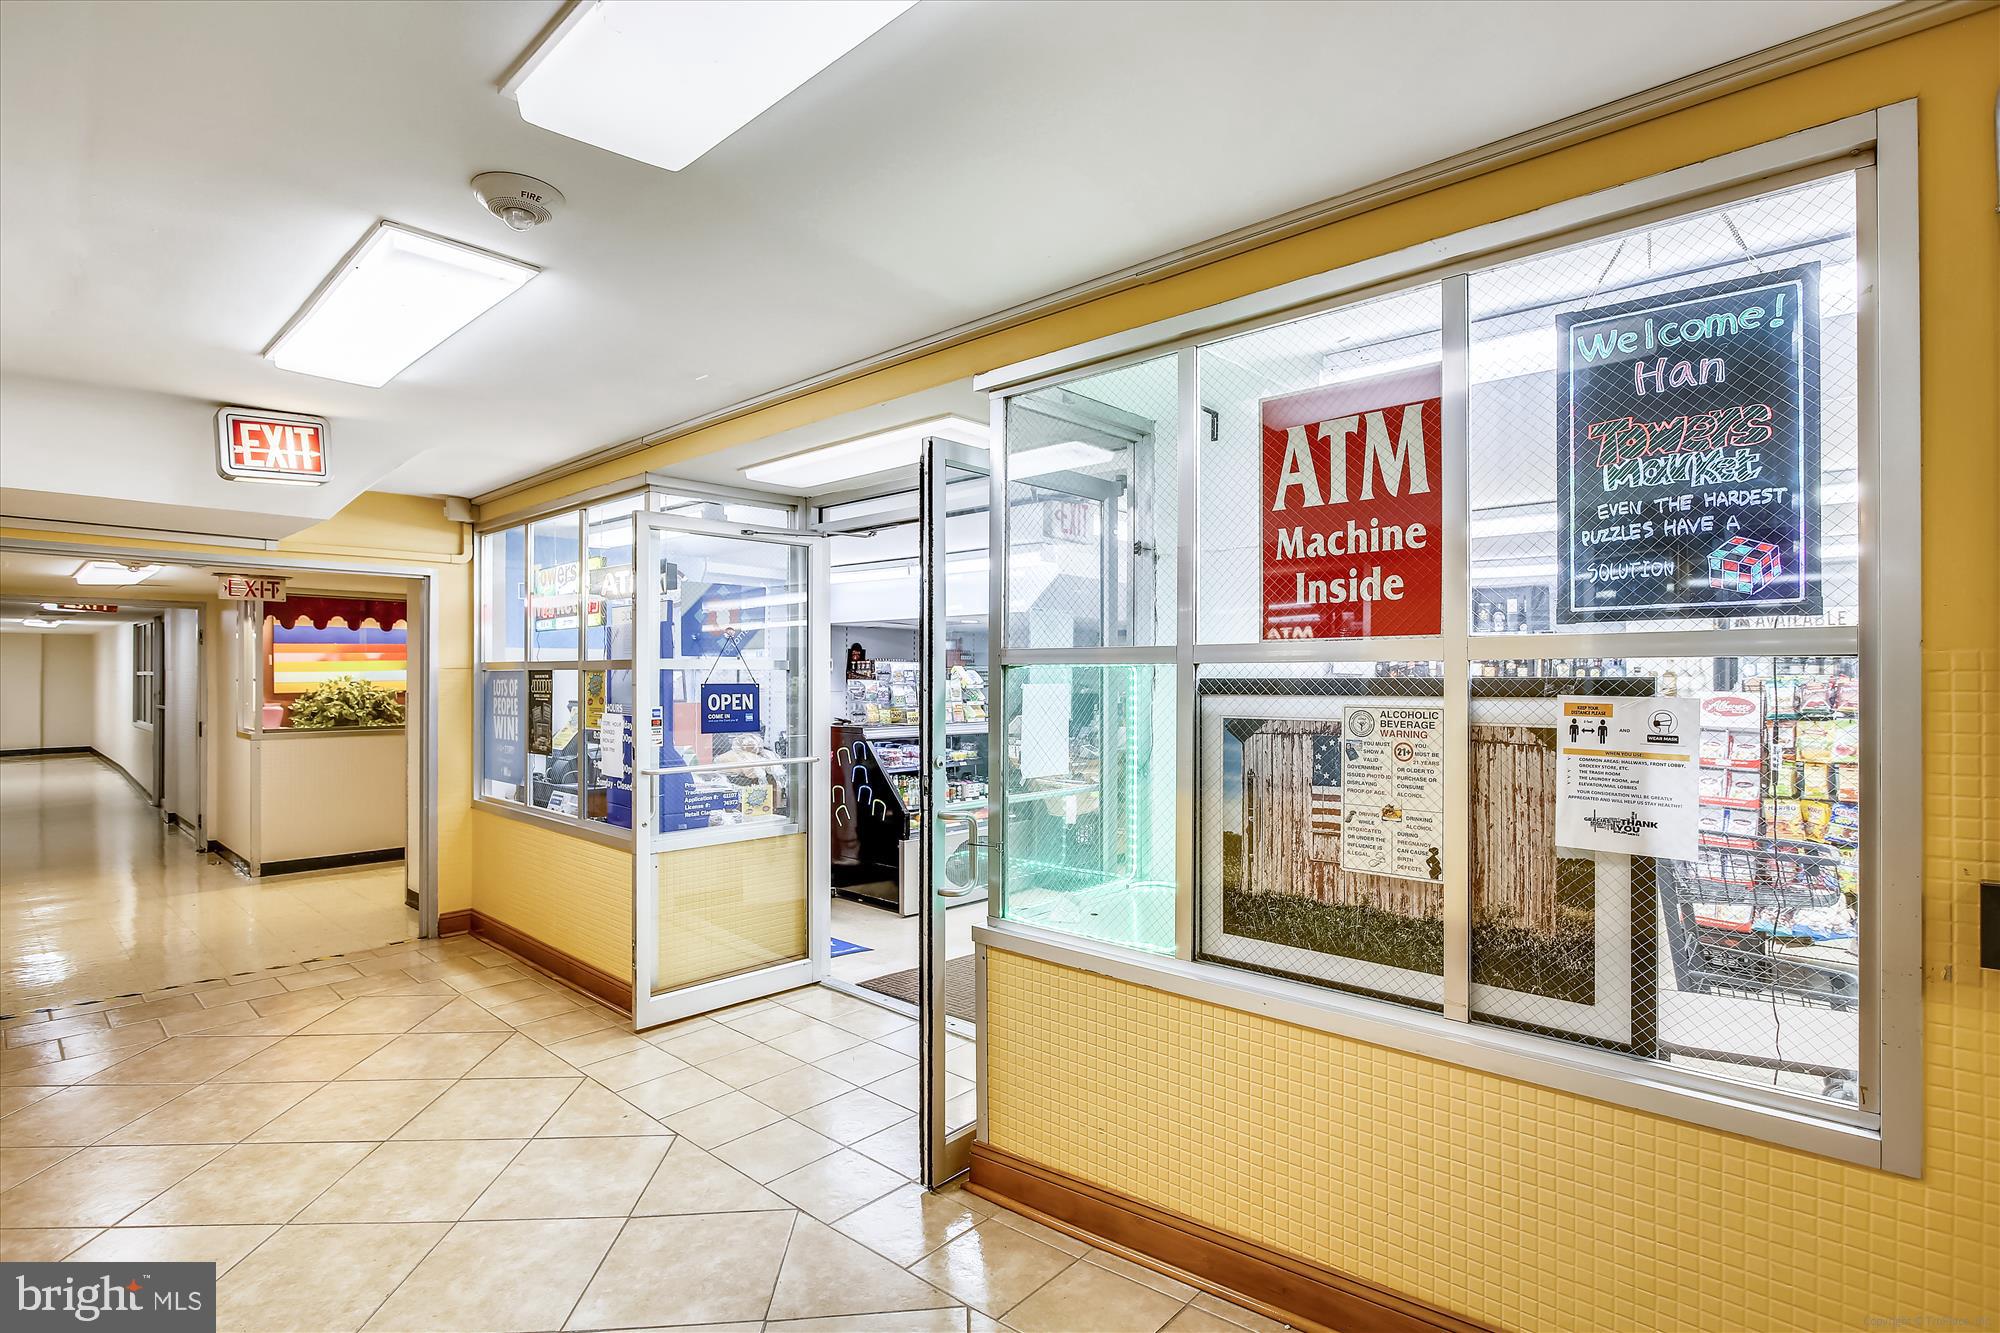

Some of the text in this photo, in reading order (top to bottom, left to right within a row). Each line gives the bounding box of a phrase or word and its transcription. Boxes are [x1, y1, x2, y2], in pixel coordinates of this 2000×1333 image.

[520, 190, 543, 203] FIRE
[1577, 293, 1785, 362] Welcome!
[1634, 356, 1726, 396] Han
[239, 422, 315, 470] EXIT
[1272, 403, 1431, 512] ATM
[1598, 487, 1788, 520] EVEN THE HARDEST
[1276, 517, 1427, 560] Machine
[1581, 515, 1740, 546] PUZZLES HAVE A
[1586, 561, 1674, 584] SOLUTION
[228, 579, 280, 599] EXIT
[601, 569, 633, 597] AT
[1296, 566, 1404, 604] Inside
[1267, 625, 1313, 639] ATM
[493, 679, 508, 696] LOTS
[509, 679, 518, 697] OF
[493, 697, 518, 715] PEOPLE
[606, 703, 623, 713] HOURS
[707, 693, 753, 711] OPEN
[1380, 711, 1439, 720] ALCOHOLIC
[1380, 720, 1436, 729] BEVERAGE
[493, 715, 518, 742] WIN!
[1380, 730, 1428, 739] WARNING
[1397, 748, 1411, 756] 21+
[597, 776, 613, 789] Sunday
[617, 780, 632, 792] Closed
[685, 795, 712, 803] Application
[1591, 790, 1630, 798] CONSIDERATION
[1616, 825, 1640, 833] YOU
[1621, 819, 1658, 829] THANK
[1347, 842, 1376, 850] INFLUENCE
